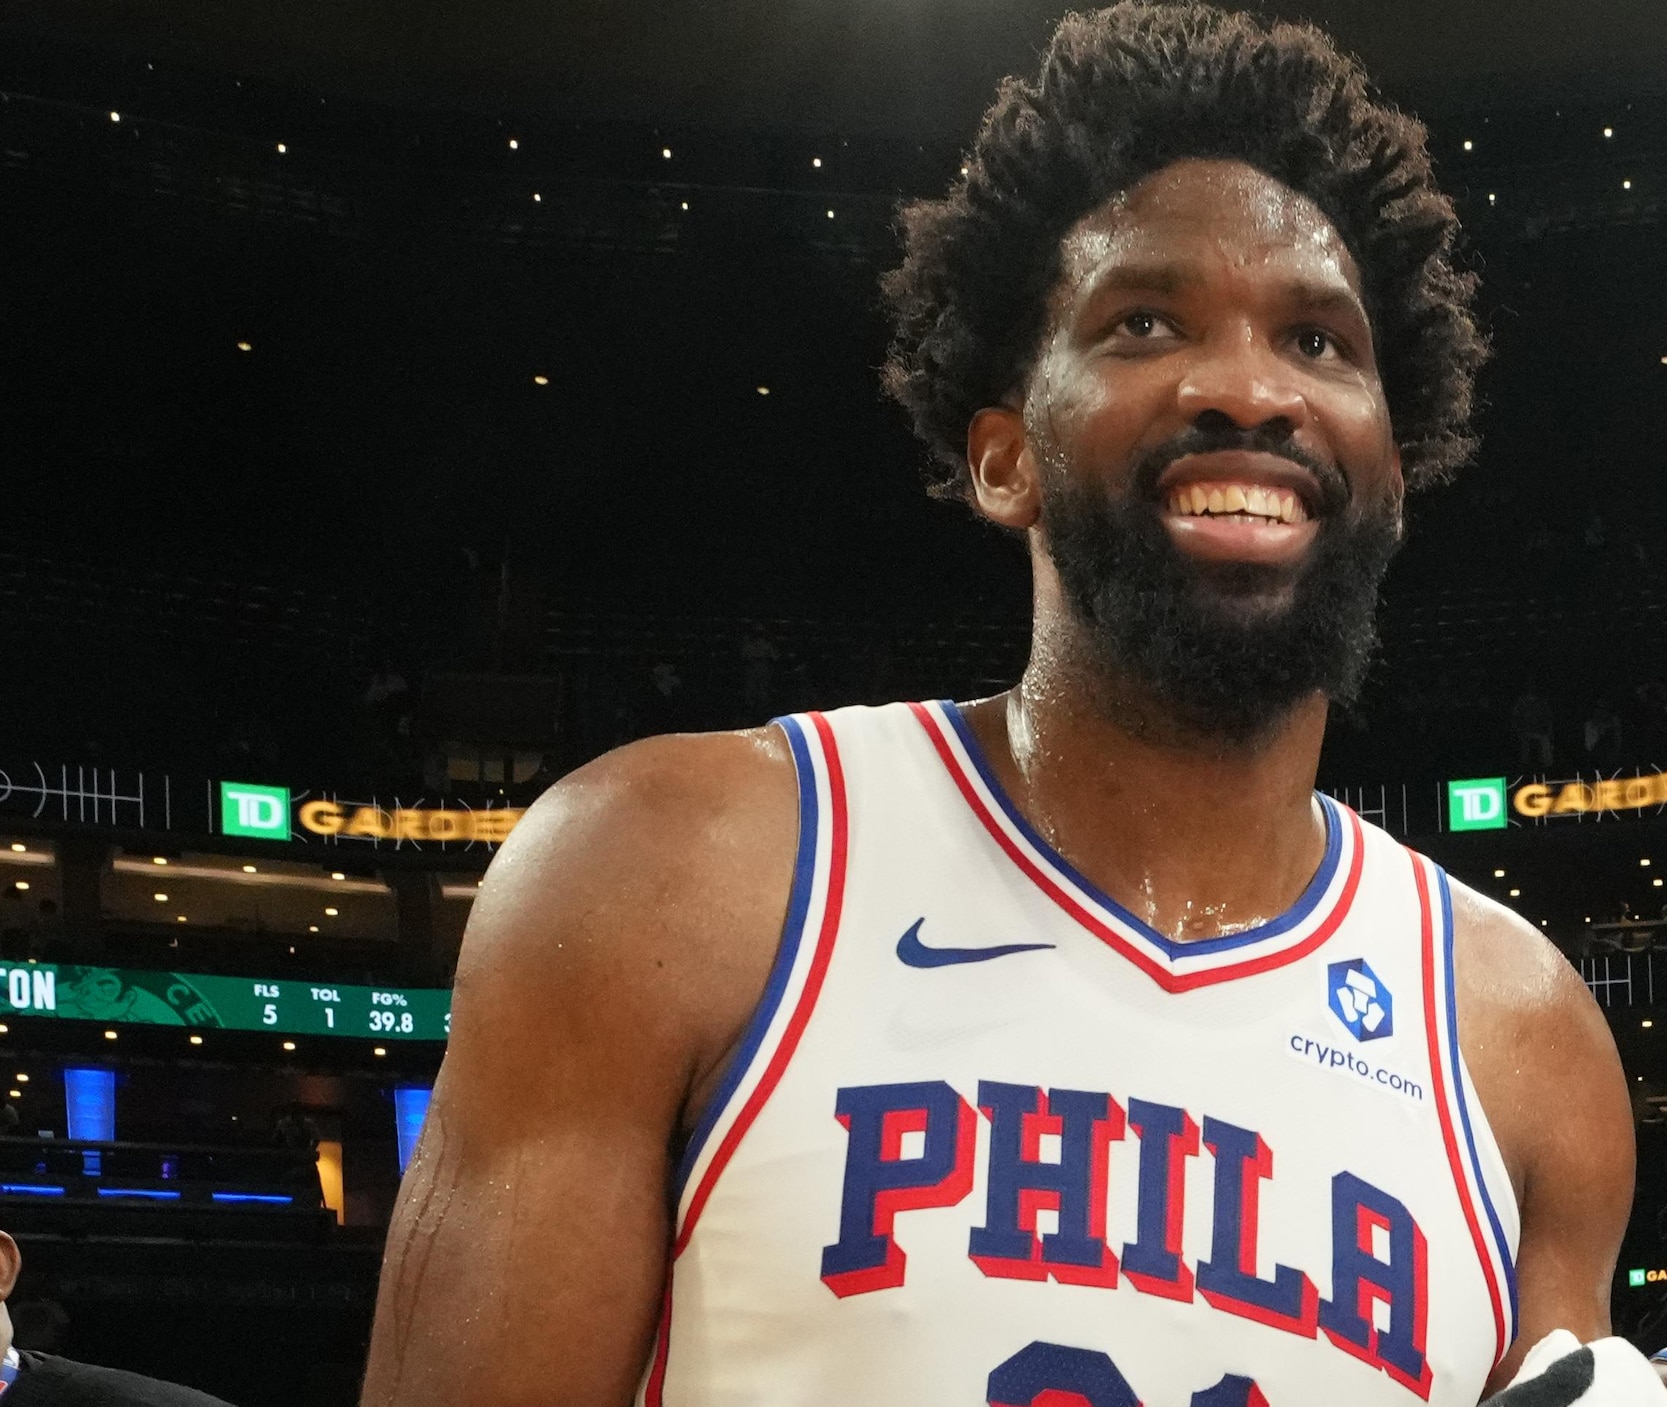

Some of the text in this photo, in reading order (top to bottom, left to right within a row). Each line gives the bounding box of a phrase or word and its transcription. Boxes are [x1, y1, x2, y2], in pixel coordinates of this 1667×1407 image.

[226, 791, 284, 829] TD
[1453, 786, 1501, 821] TD
[0, 967, 57, 1010] ON
[254, 984, 408, 1007] FLS TOL FG%
[263, 1004, 414, 1033] 5 1 39.8
[1288, 1029, 1425, 1102] crypto.com
[821, 1078, 1434, 1402] PHILA
